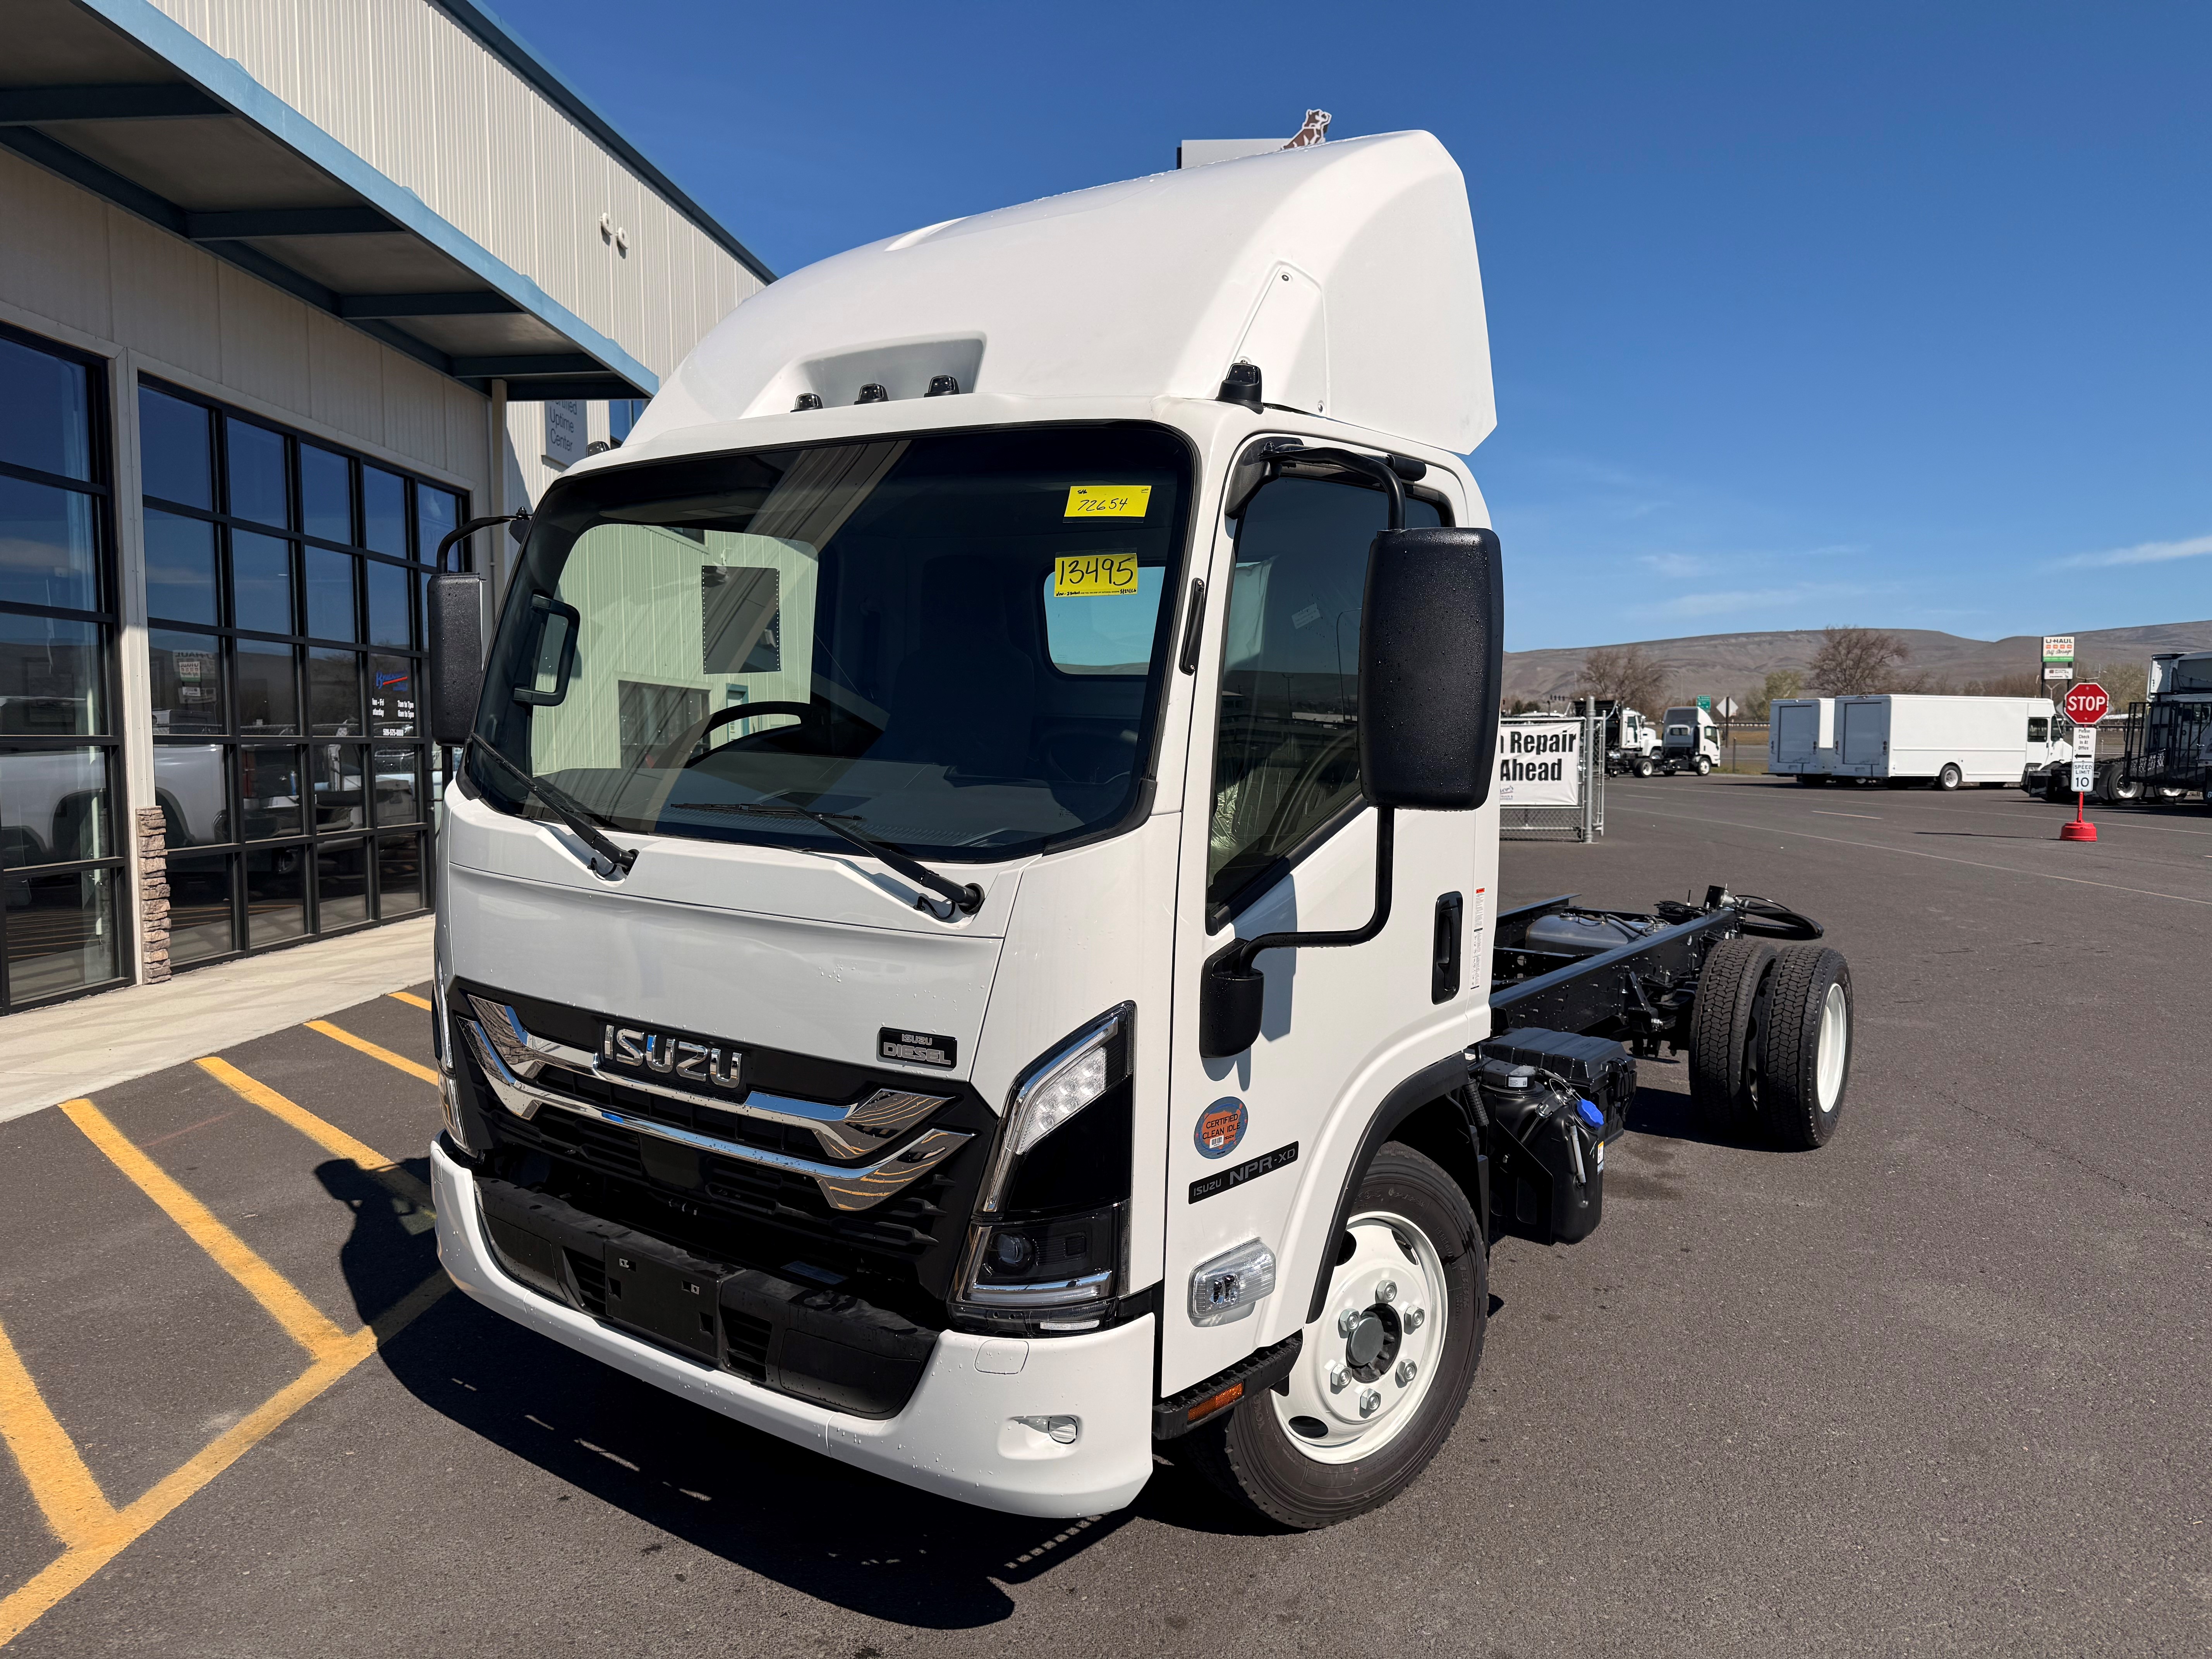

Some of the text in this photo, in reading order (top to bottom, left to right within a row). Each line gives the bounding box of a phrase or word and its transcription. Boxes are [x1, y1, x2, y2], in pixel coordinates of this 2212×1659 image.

[550, 406, 574, 433] Uptime
[551, 428, 573, 452] Center
[1077, 498, 1128, 511] 72654
[1059, 557, 1133, 586] 13495
[373, 708, 384, 717] aturday
[2067, 696, 2106, 711] STOP
[1510, 730, 1577, 755] Repair
[1501, 758, 1562, 781] Ahead
[2076, 777, 2089, 787] 10
[902, 1034, 933, 1046] ISUZU
[604, 1025, 742, 1089] ISUZU
[883, 1042, 951, 1065] DIESEL
[1202, 1127, 1224, 1140] CLEAN
[1227, 1122, 1241, 1133] IDLE
[1206, 1114, 1238, 1129] CERTIFIED
[1194, 1148, 1295, 1197] ISUZU NPR-XD
